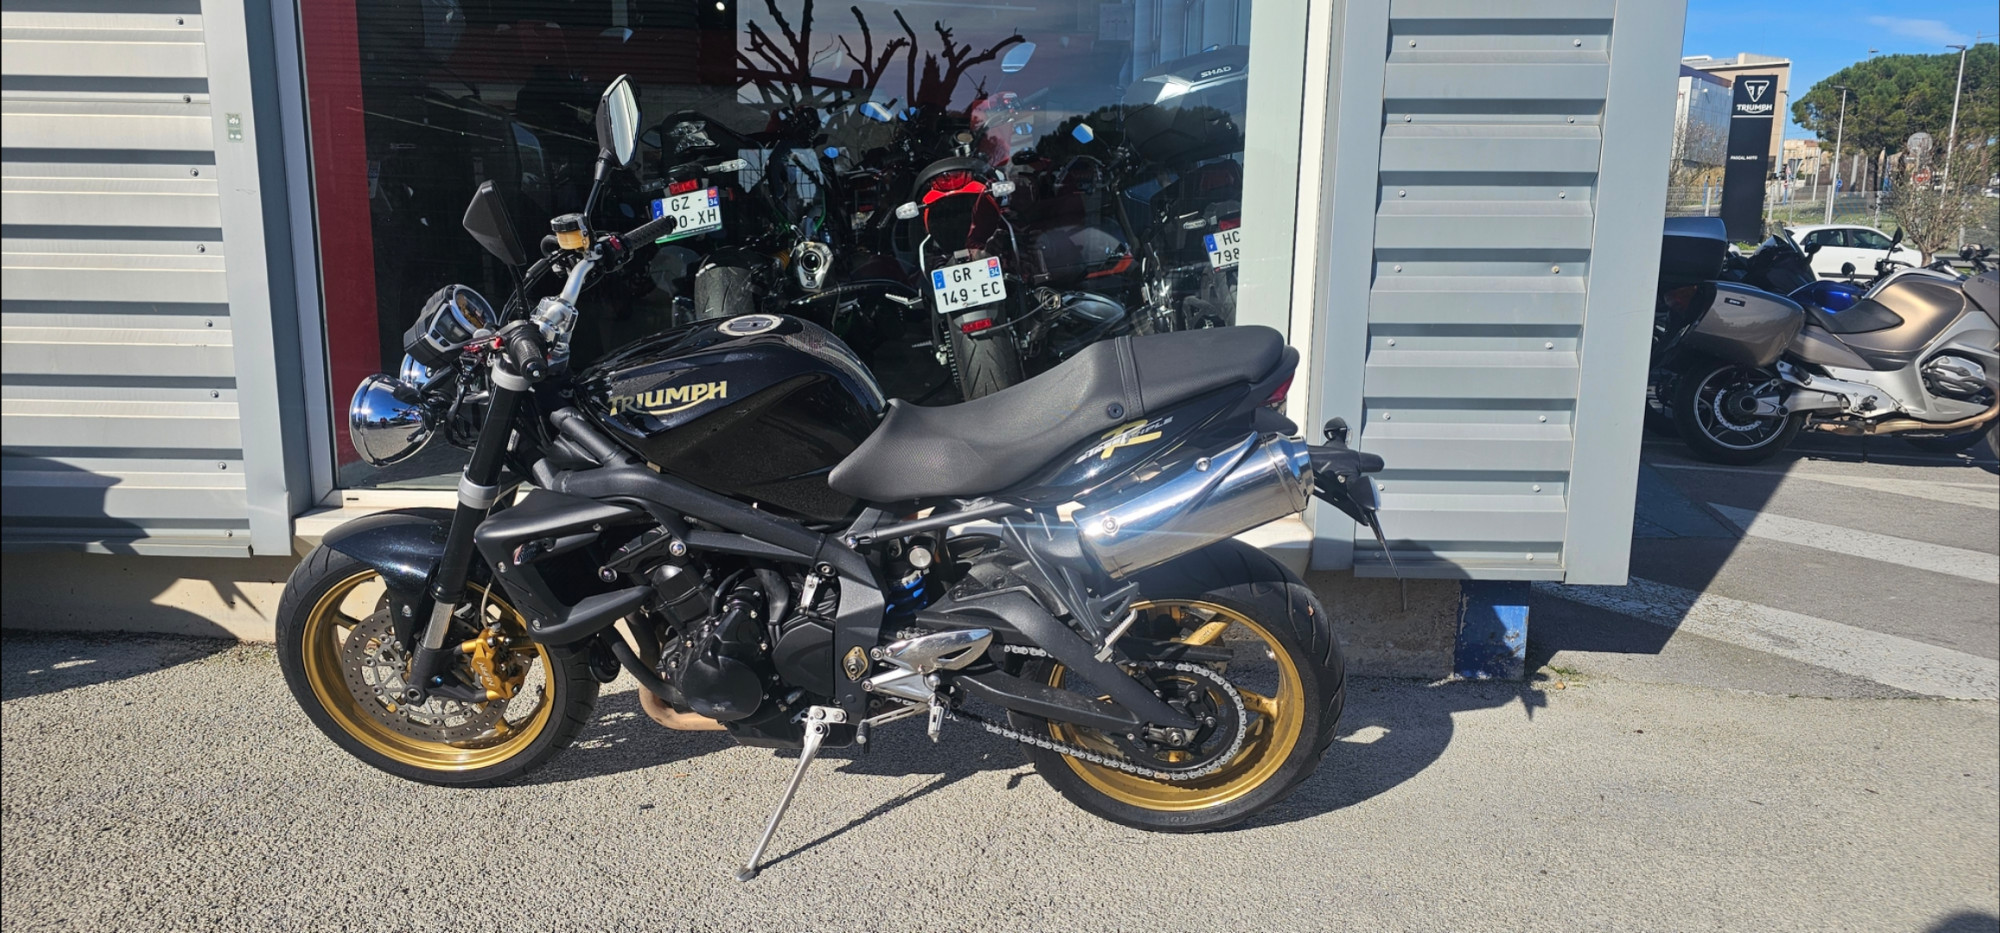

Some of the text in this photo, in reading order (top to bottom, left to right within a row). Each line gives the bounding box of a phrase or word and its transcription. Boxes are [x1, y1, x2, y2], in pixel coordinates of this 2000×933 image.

[1200, 65, 1232, 78] SHAD
[1736, 103, 1773, 113] TRIUMPH
[671, 196, 690, 212] GZ
[709, 197, 718, 206] 34
[1222, 230, 1240, 246] HC
[952, 267, 972, 283] GR
[989, 268, 1000, 277] 34
[607, 380, 728, 416] TRIUMPH
